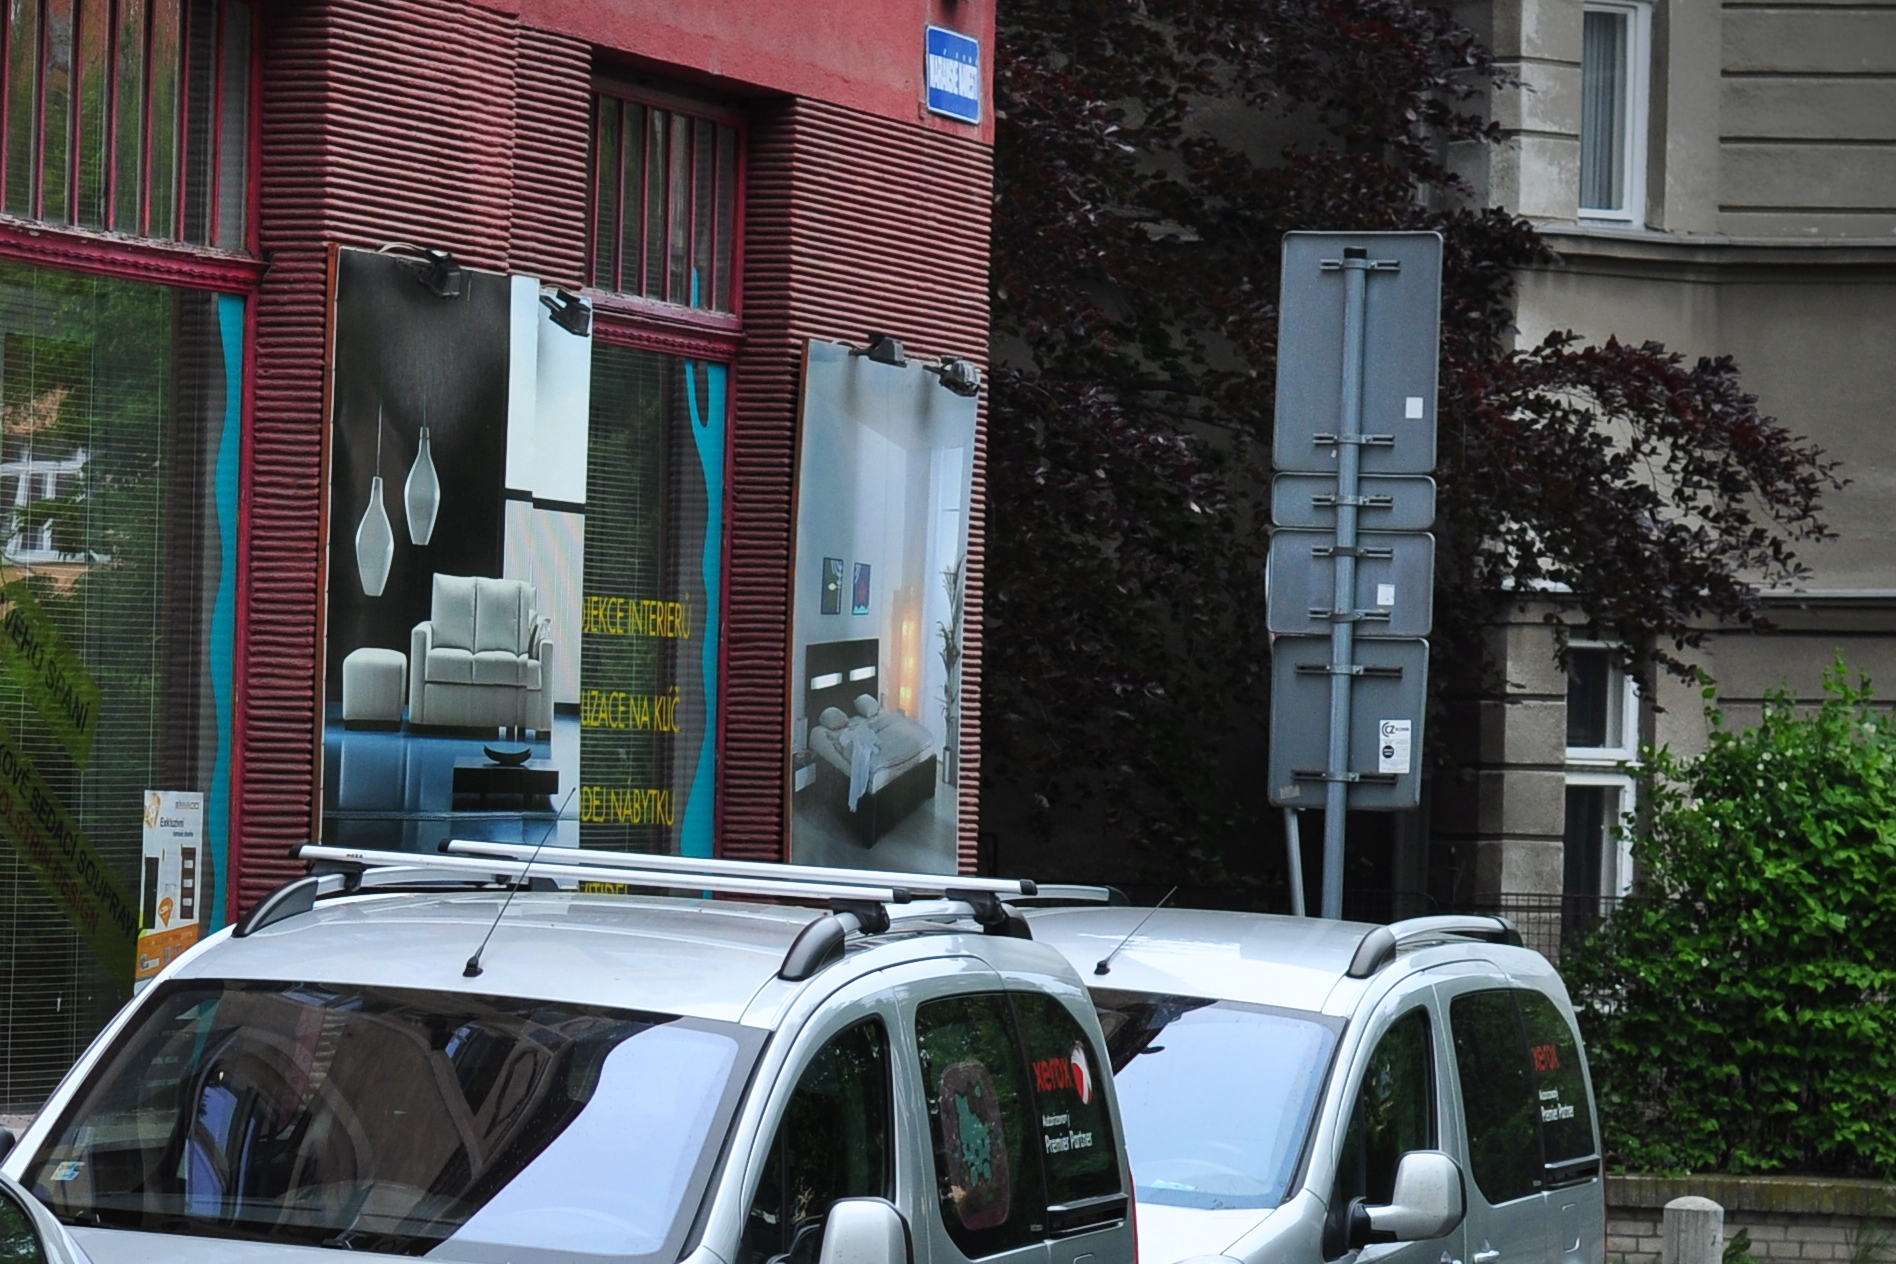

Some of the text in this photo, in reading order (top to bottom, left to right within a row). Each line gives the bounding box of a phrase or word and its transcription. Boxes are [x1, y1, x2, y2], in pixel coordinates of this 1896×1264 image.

[583, 596, 625, 633] JEKCE
[629, 694, 651, 730] NA
[654, 685, 681, 733] KLÍČ
[30, 786, 79, 862] SEDACÍ
[611, 776, 675, 826] NÁBYTKU
